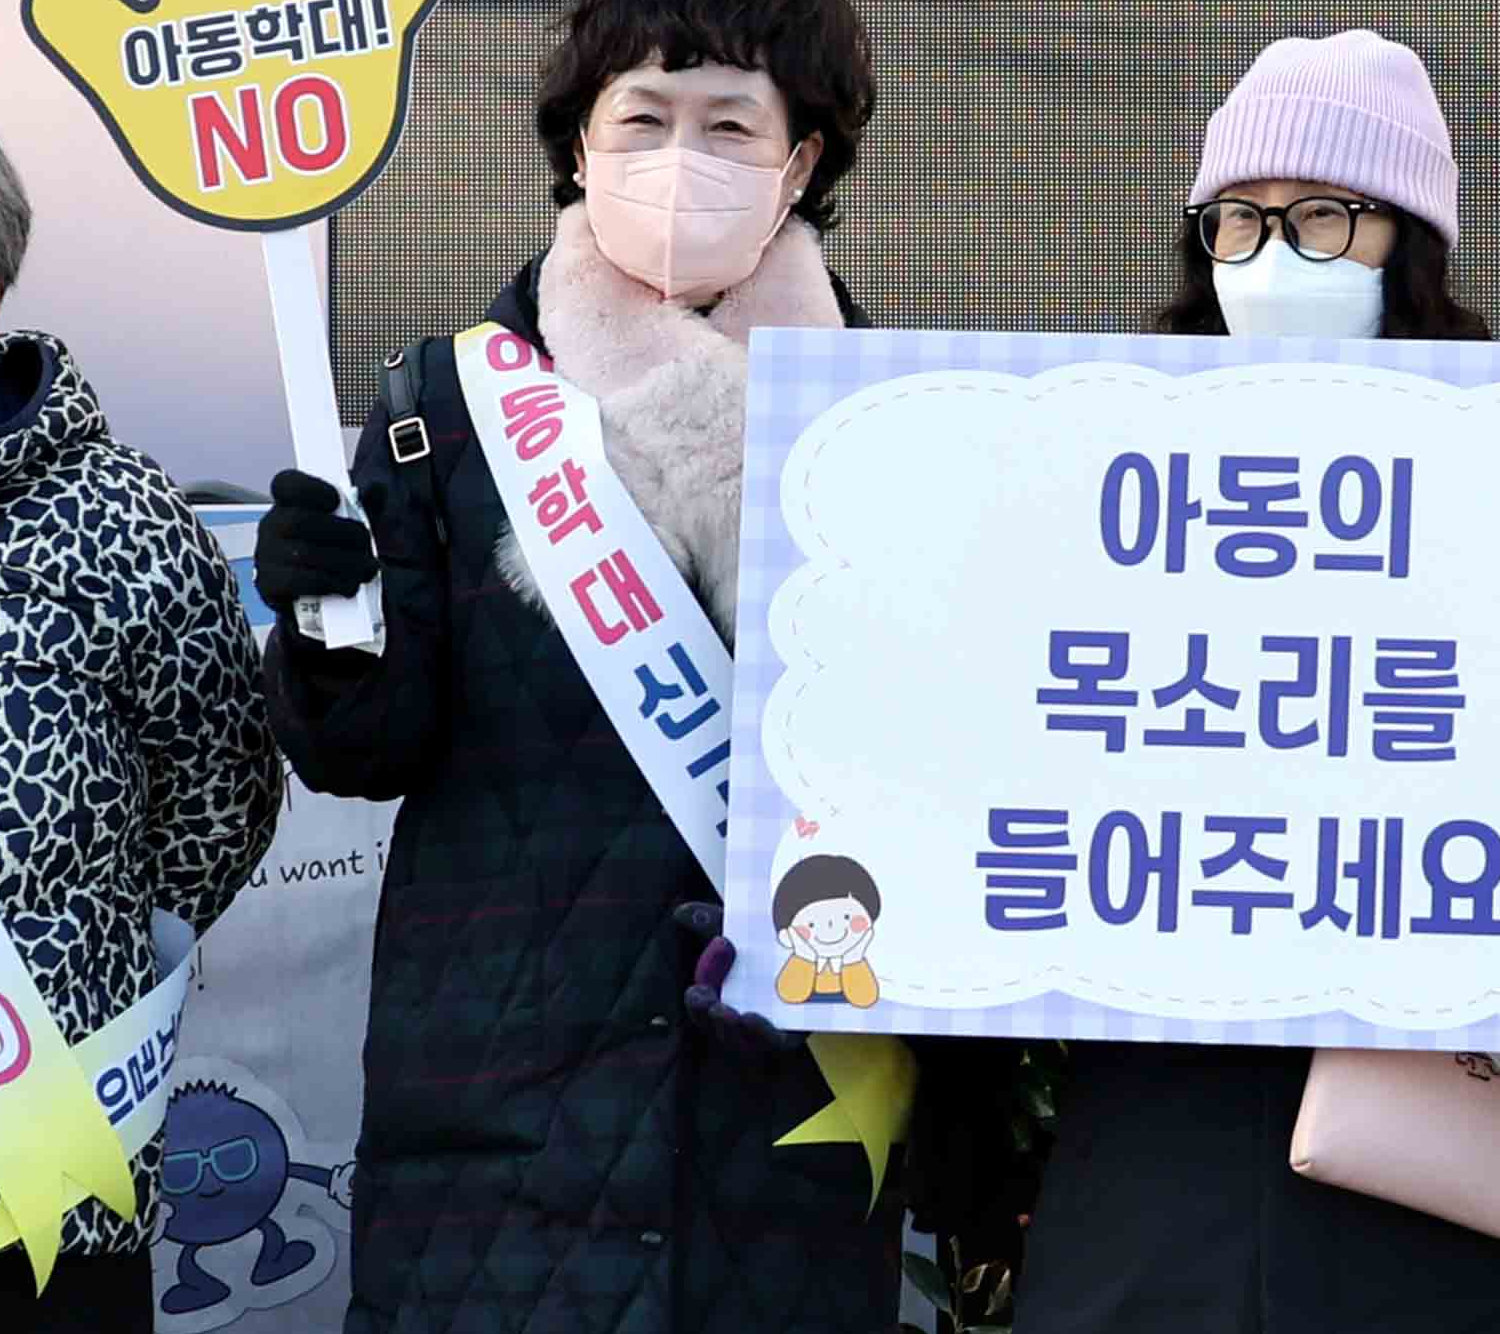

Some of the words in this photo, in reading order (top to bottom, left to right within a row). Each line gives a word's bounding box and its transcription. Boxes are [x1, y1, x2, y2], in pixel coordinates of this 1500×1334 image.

[190, 77, 348, 190] NO
[1099, 450, 1415, 580] 아동의
[1035, 628, 1467, 762] 목소리를
[279, 849, 365, 884] want
